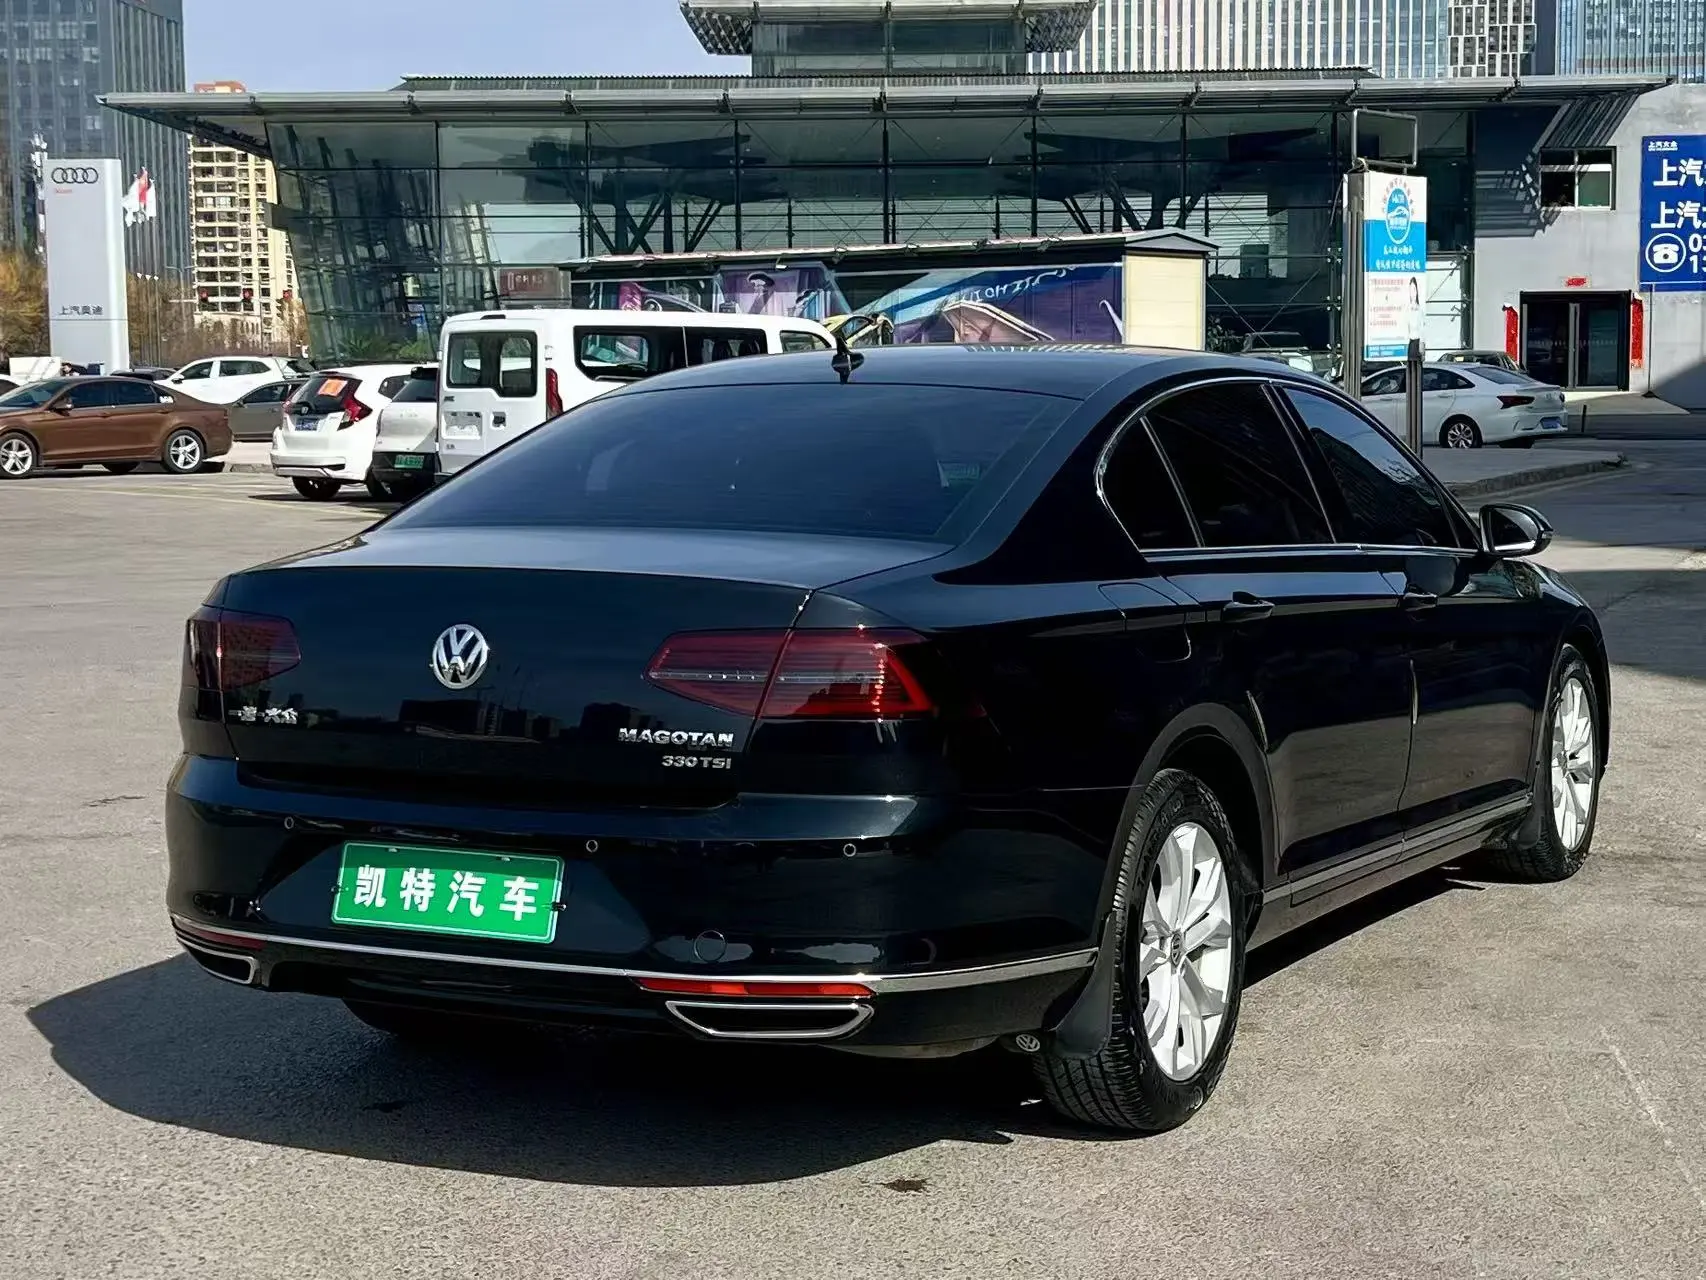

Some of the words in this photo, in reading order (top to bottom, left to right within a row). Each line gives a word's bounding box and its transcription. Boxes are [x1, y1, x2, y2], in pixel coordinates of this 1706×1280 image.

[1653, 158, 1706, 187] 上汽
[1650, 200, 1706, 229] 上汽
[1688, 233, 1706, 253] 0
[1689, 254, 1706, 274] 1
[618, 727, 734, 748] MAGOTAN
[353, 863, 540, 922] 凯特汽车
